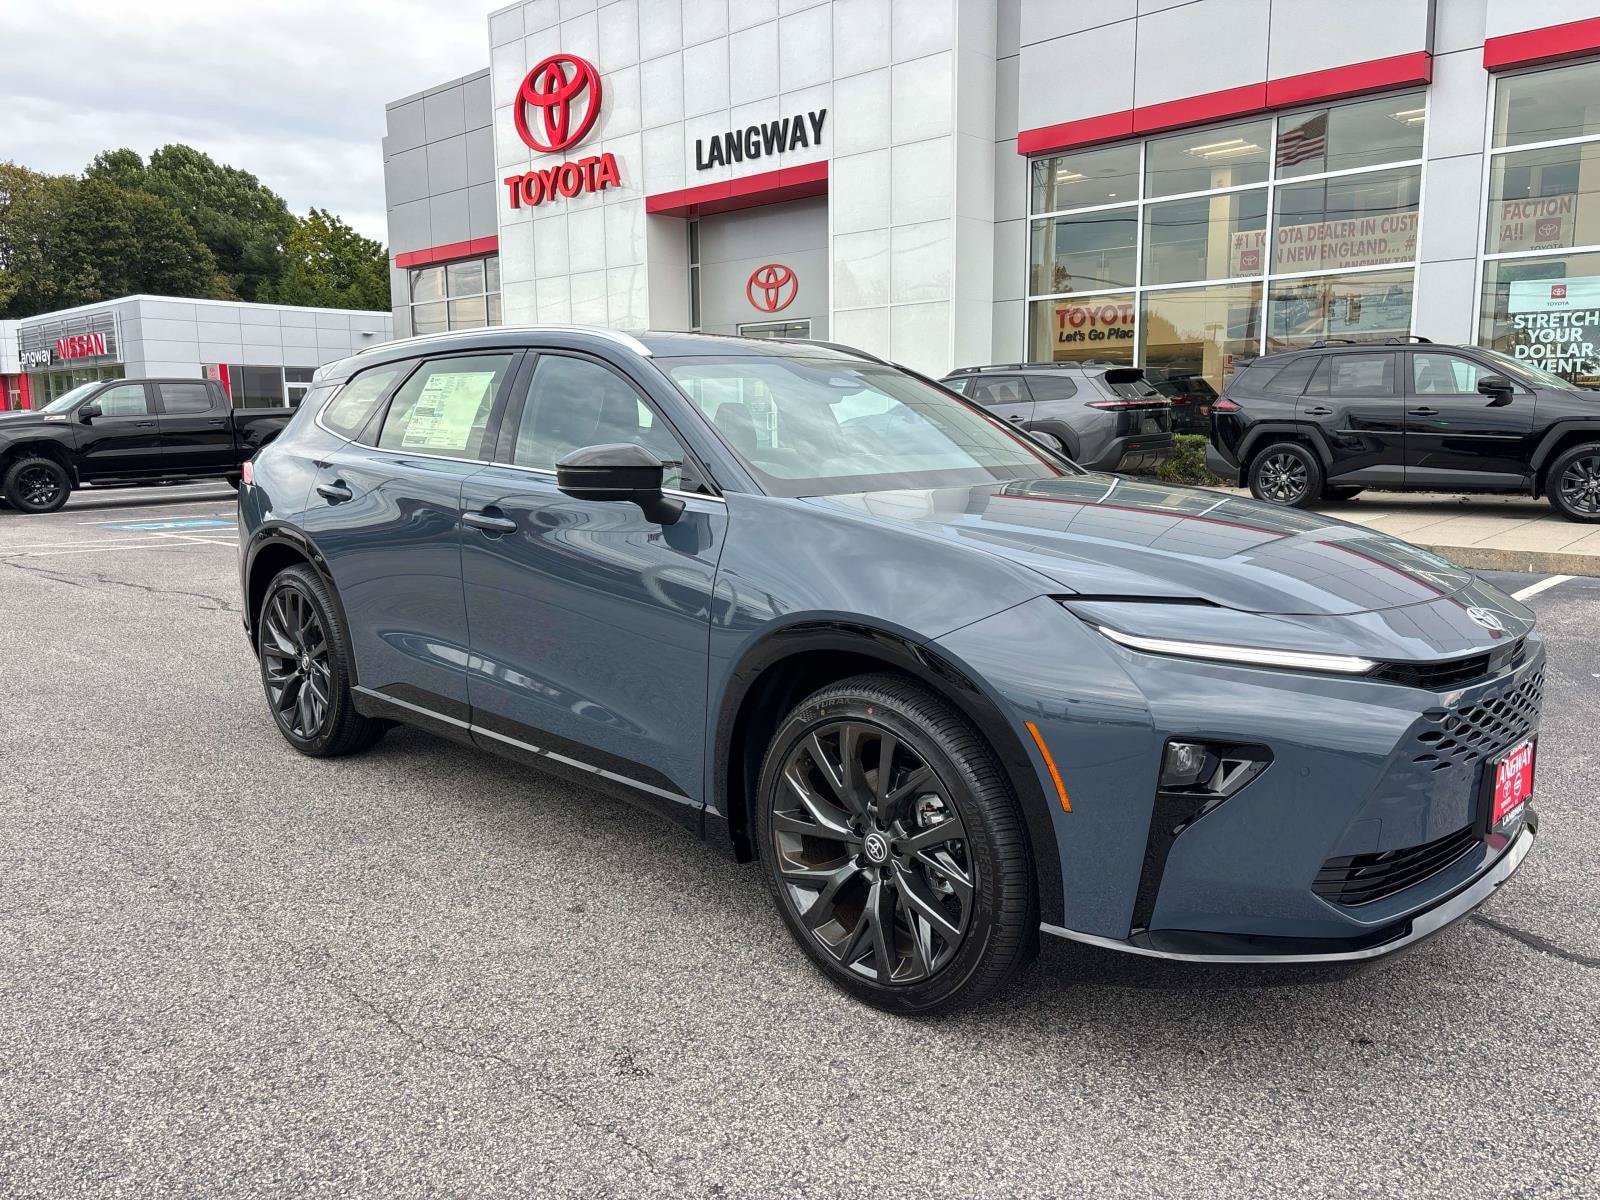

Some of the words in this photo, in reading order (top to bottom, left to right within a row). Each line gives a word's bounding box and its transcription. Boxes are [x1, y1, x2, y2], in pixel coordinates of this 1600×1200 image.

[695, 108, 827, 171] LANGWAY
[503, 152, 621, 209] TOYOTA
[1501, 197, 1571, 220] FACTION
[1234, 236, 1249, 249] #1
[1254, 229, 1304, 248] TOOTA
[1307, 220, 1356, 242] DEALER
[1361, 218, 1376, 235] IN
[1380, 213, 1418, 234] CUST
[1500, 222, 1525, 241] A!!
[1287, 246, 1315, 264] NEW
[1320, 239, 1400, 260] ENGLAND...
[1514, 311, 1600, 329] STRETCH
[56, 332, 107, 359] NISSAN
[1058, 330, 1086, 343] Let's
[1088, 328, 1105, 340] Go
[1107, 327, 1135, 340] Plac
[1528, 327, 1583, 343] YOUR
[18, 348, 52, 367] Langway
[1515, 343, 1594, 359] DOLLAR
